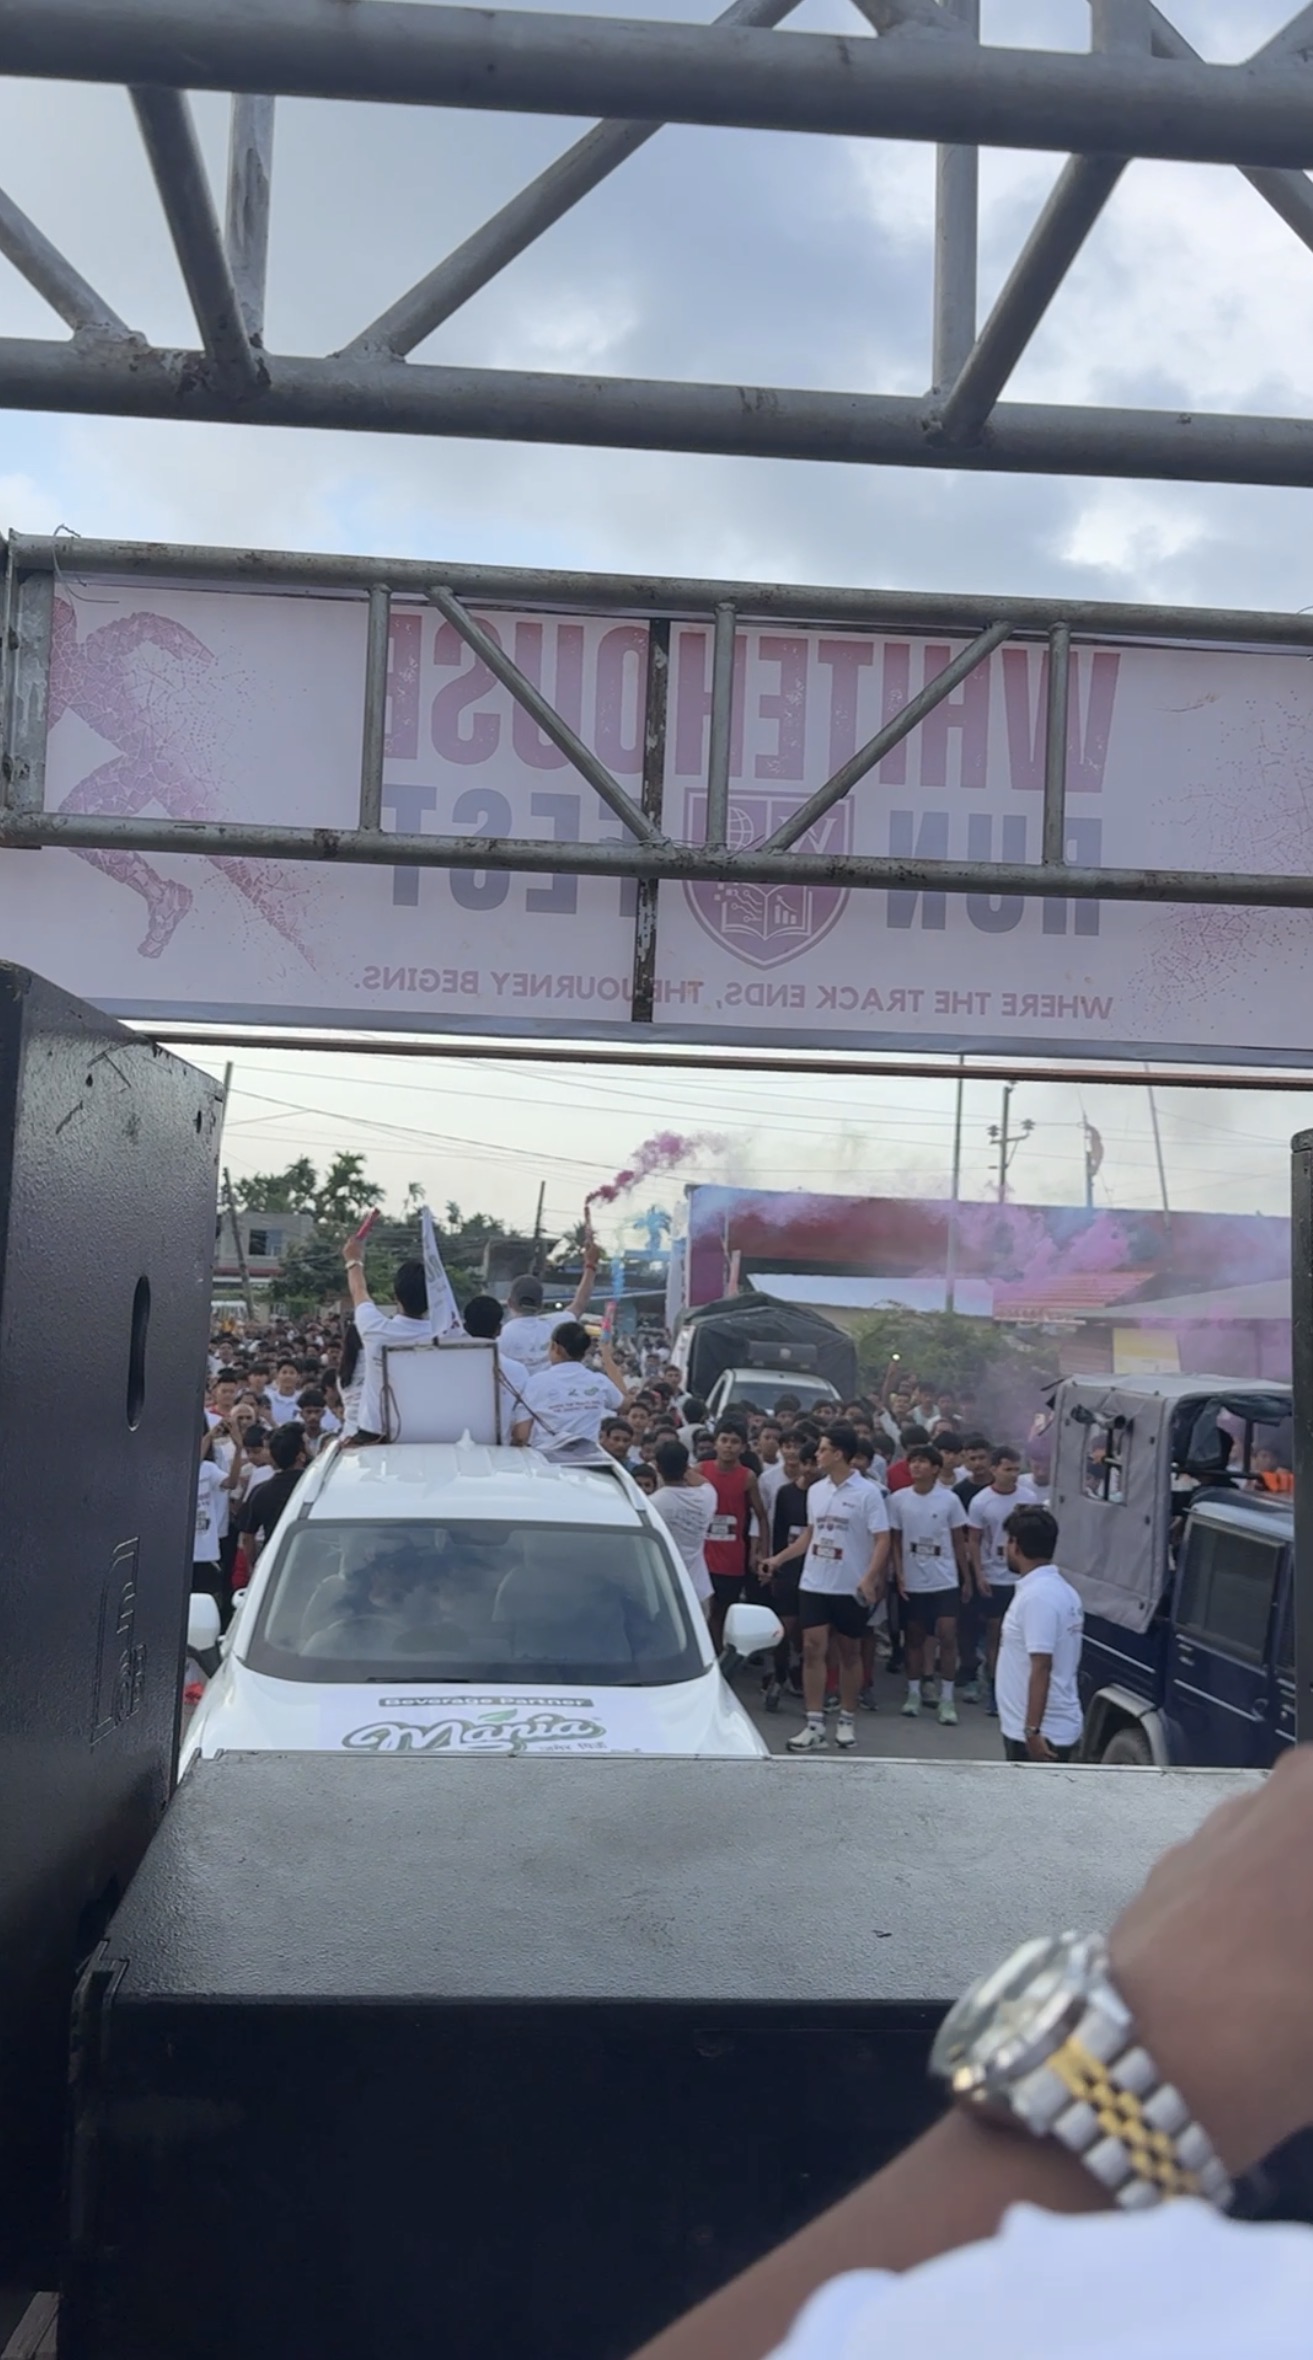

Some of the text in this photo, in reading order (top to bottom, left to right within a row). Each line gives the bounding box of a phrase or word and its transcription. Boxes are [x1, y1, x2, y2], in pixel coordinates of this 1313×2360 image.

[384, 1696, 586, 1706] Beverage Partner
[342, 1714, 606, 1751] Mania
